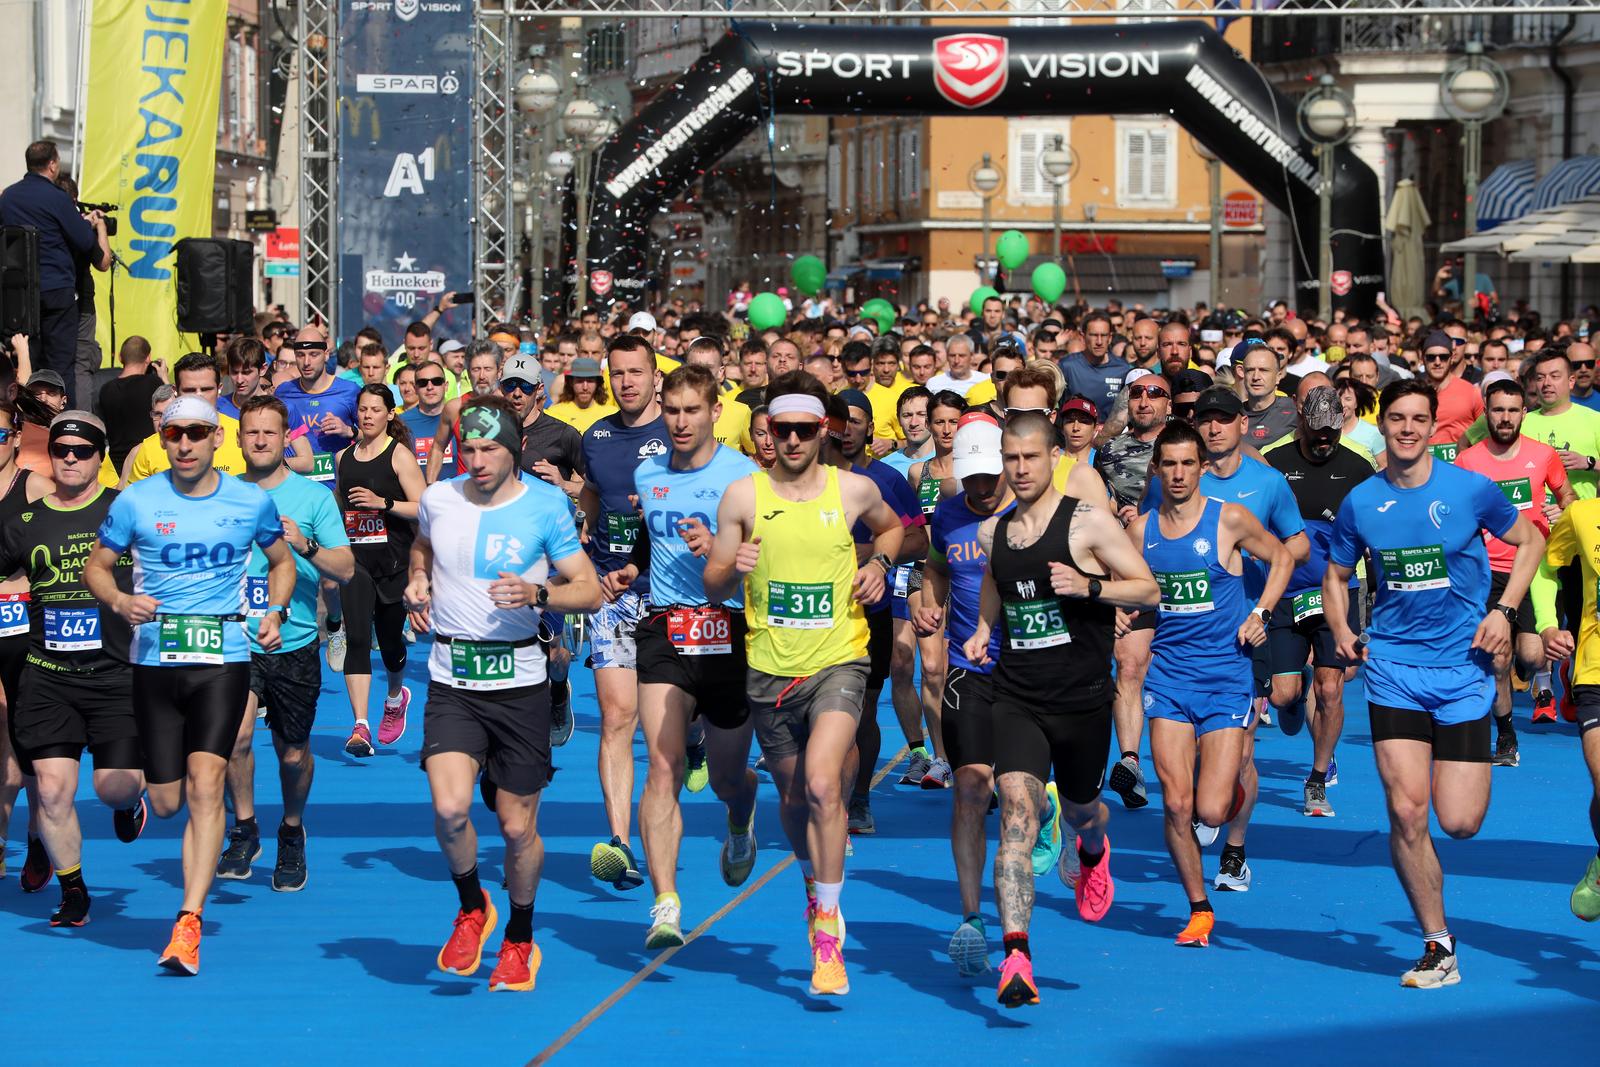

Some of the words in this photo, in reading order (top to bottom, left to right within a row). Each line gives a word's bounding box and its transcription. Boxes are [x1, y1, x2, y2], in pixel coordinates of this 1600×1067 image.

[351, 2, 393, 12] SPORT
[420, 3, 461, 12] VISION
[776, 52, 919, 79] SPORT
[1019, 51, 1160, 79] VISION
[373, 78, 435, 89] SPAR
[383, 147, 435, 198] A1
[1225, 210, 1256, 221] KING
[371, 274, 436, 288] Heineken
[592, 429, 611, 439] spin
[1512, 486, 1522, 500] 4
[358, 518, 385, 533] 408
[648, 510, 711, 538] CRO
[161, 542, 235, 569] CRO
[1404, 561, 1433, 578] 887
[1172, 580, 1208, 600] 219
[790, 594, 832, 614] 316
[61, 618, 98, 638] 647
[689, 620, 729, 640] 608
[1022, 610, 1064, 634] 295
[184, 628, 222, 648] 105
[42, 661, 57, 670] one
[472, 654, 512, 675] 120
